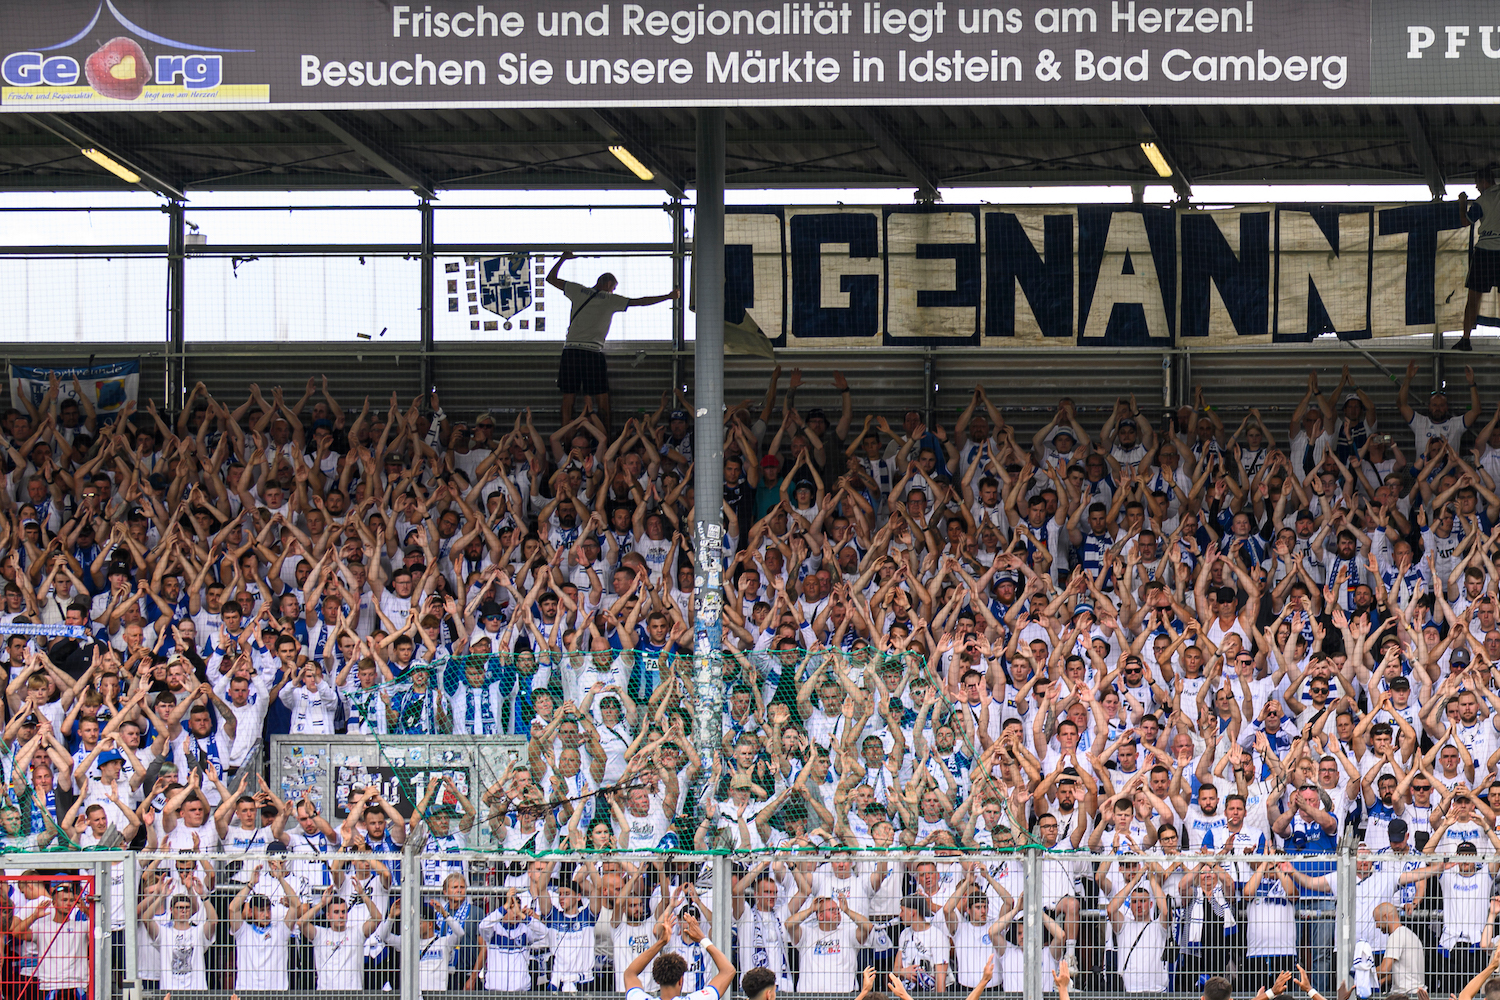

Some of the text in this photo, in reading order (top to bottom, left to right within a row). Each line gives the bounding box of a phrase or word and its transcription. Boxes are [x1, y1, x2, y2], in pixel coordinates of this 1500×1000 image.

[393, 0, 1253, 43] Frische und Regionalität liegt uns am Herzen!
[300, 48, 1348, 90] Besuchen Sie unsere Märkte in Idstein & Bad Camberg
[8, 91, 93, 102] Frische und Regionalität
[161, 91, 175, 99] uns
[190, 90, 219, 98] Herzen!
